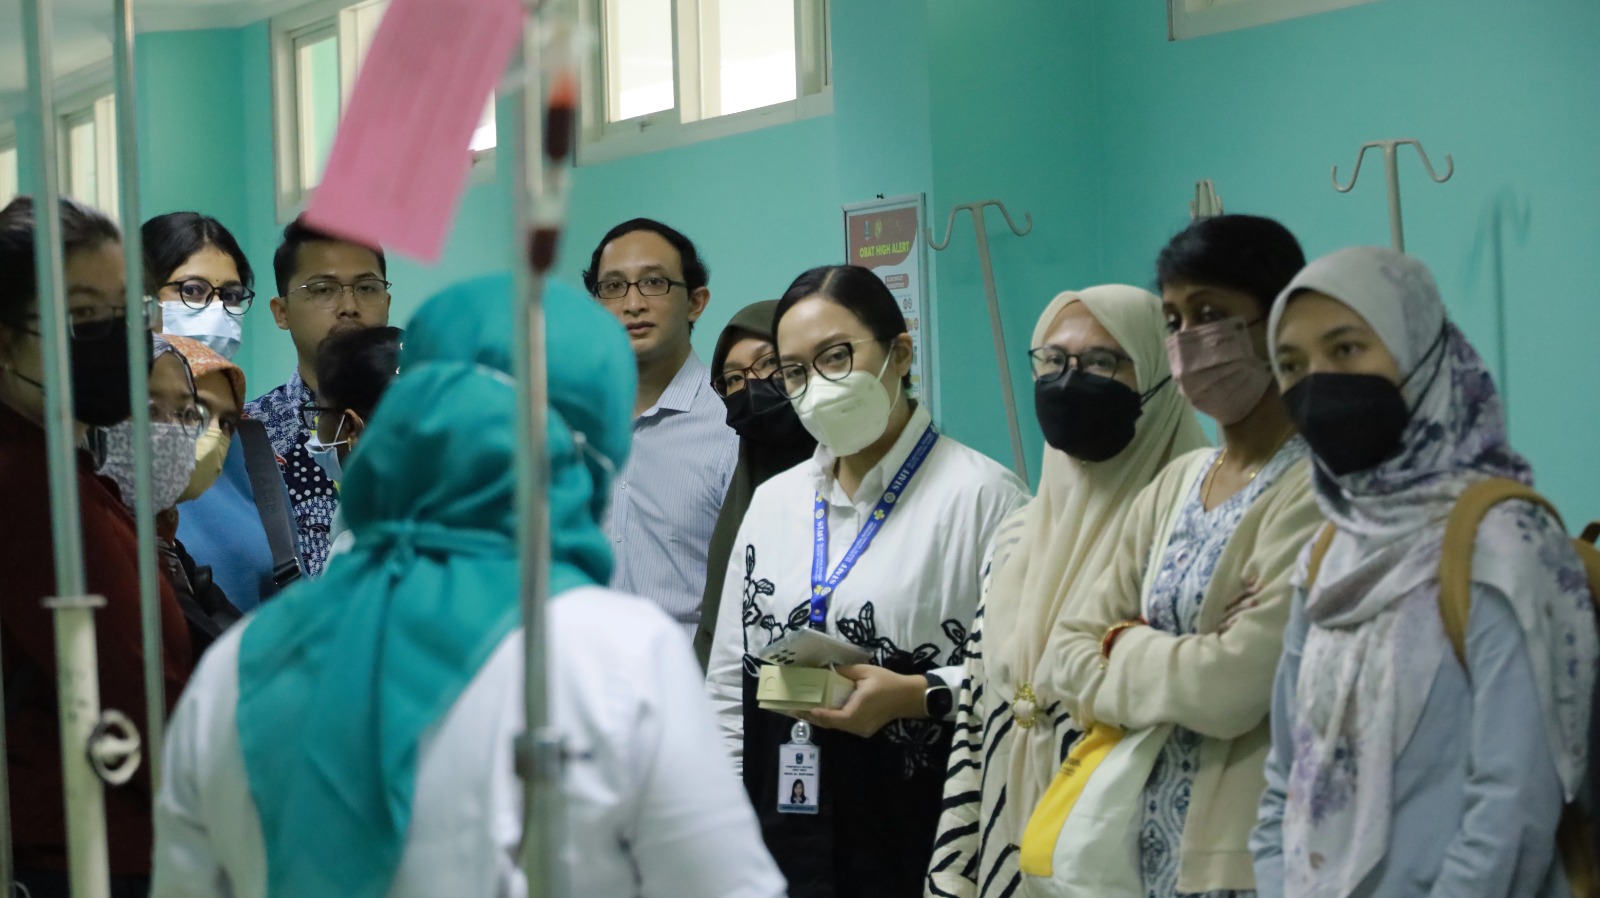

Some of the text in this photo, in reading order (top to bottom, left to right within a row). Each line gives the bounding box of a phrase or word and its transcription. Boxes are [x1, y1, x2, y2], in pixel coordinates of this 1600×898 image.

[860, 241, 909, 258] OBAT HIGH ALERT
[891, 468, 910, 490] STAFF
[816, 520, 825, 542] STAFF
[829, 562, 848, 585] STAFF
